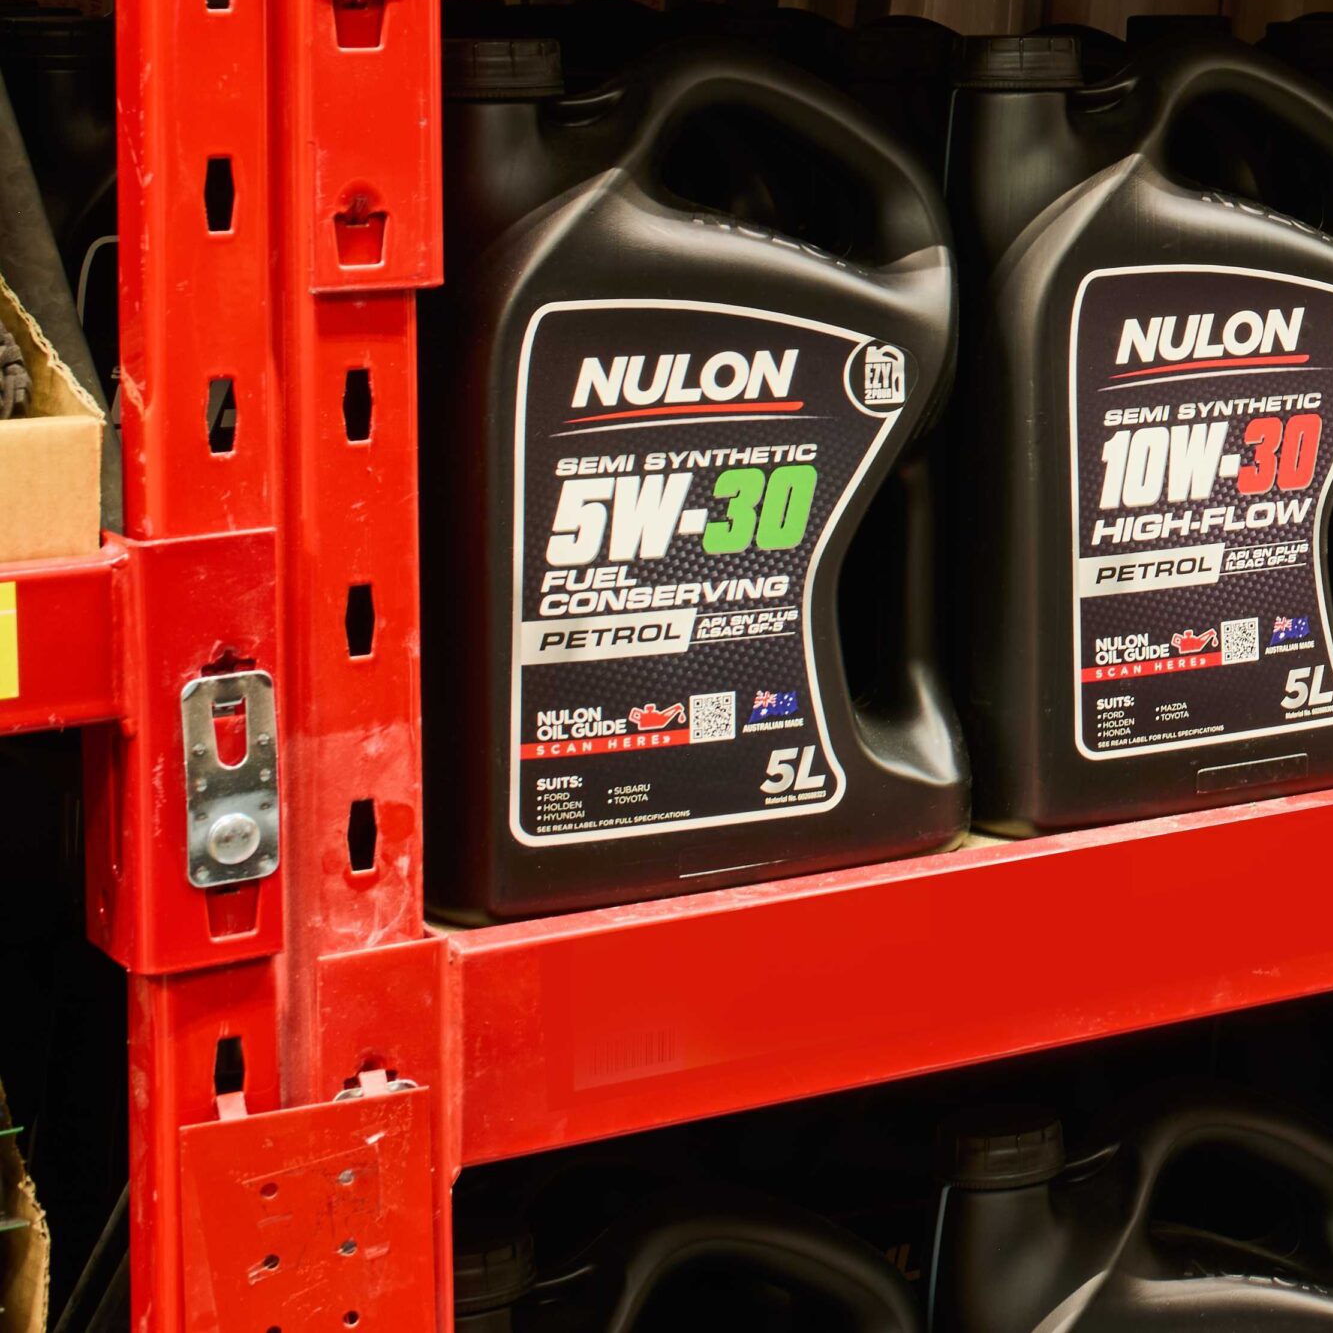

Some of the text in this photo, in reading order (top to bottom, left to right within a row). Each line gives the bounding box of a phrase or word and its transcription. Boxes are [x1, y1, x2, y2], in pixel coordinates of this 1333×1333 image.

[1115, 307, 1305, 365] NULON
[571, 348, 799, 408] NULON
[556, 444, 818, 476] SEMI SYNTHETIC
[1100, 413, 1323, 509] 10W-30
[545, 465, 818, 566] 5W-30
[1091, 498, 1312, 545] HIGH-FLOW
[540, 566, 637, 592] FUEL
[1096, 556, 1212, 584] PETROL
[538, 575, 790, 617] CONSERVING
[538, 622, 682, 651] PETROL
[536, 718, 627, 741] OIL GUIDE
[536, 776, 582, 791] SUITS:
[759, 744, 826, 794] 5L
[614, 792, 648, 805] TOYOTA
